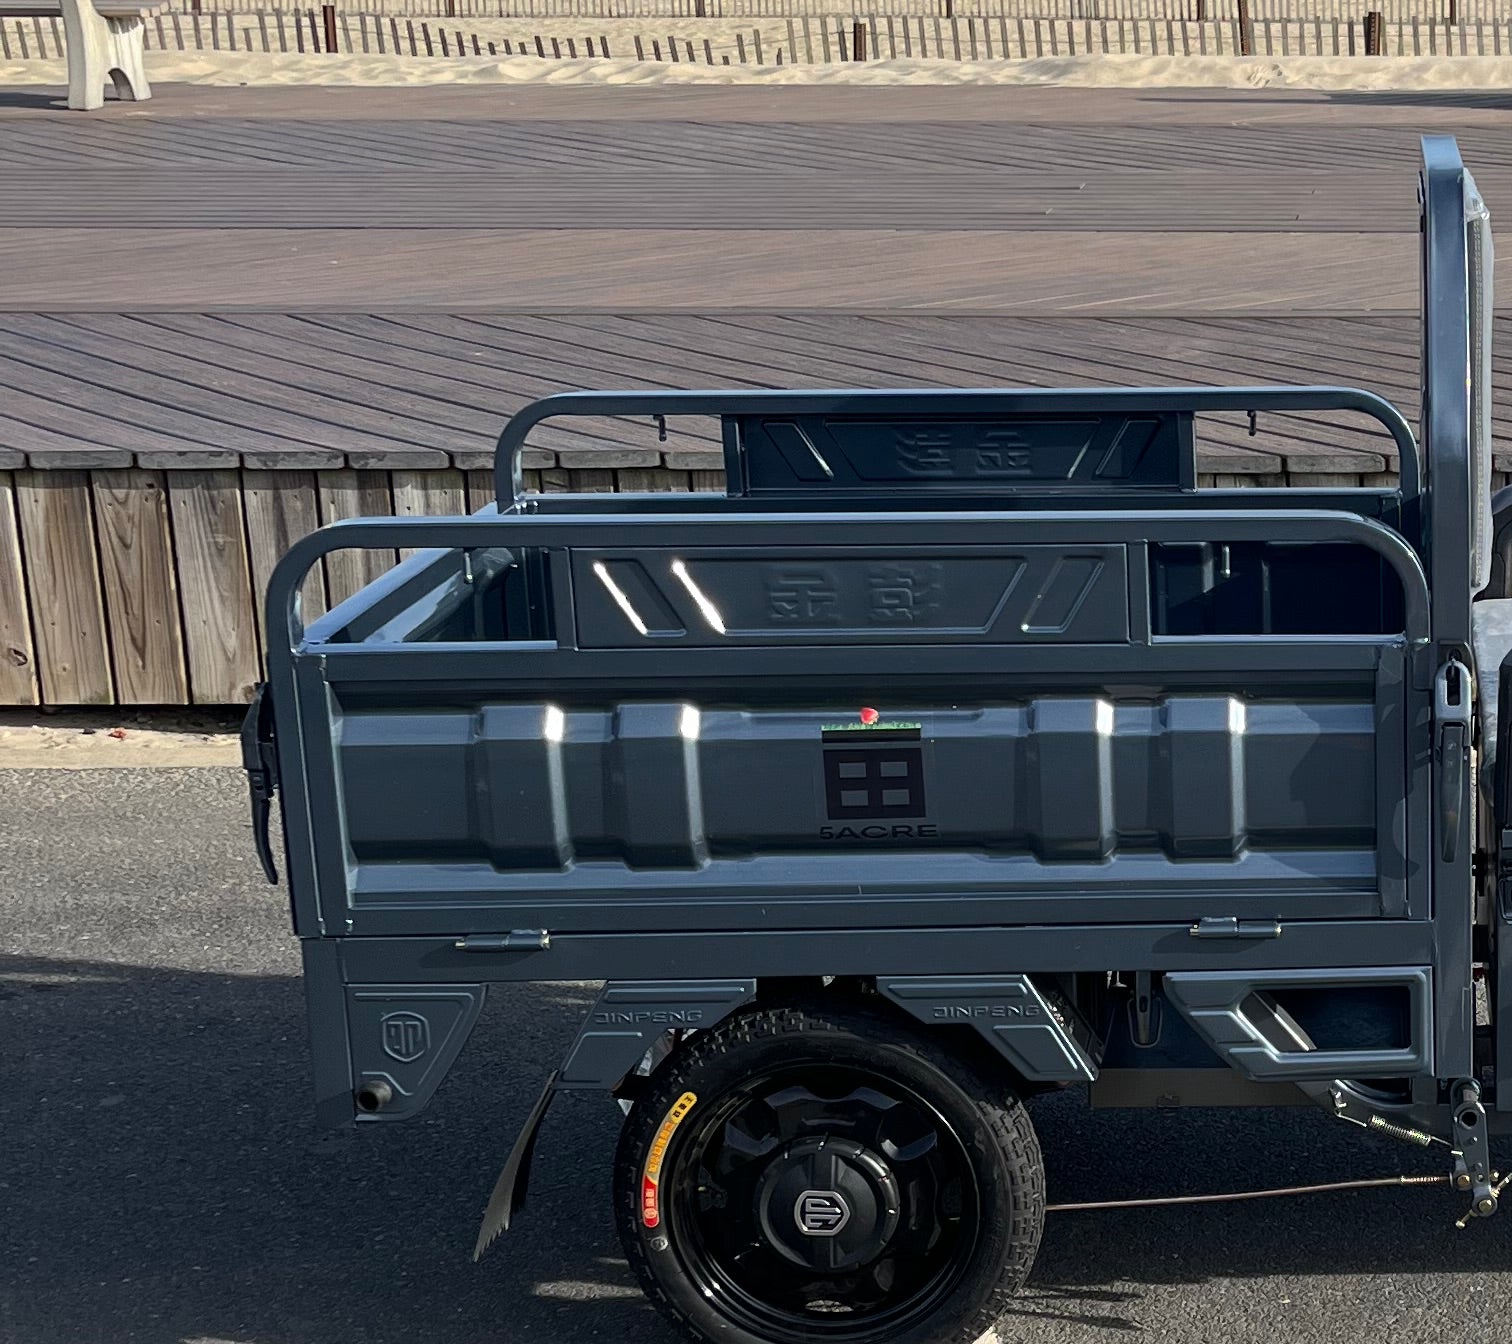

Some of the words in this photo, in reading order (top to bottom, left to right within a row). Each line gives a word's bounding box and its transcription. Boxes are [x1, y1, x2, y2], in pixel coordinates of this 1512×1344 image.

[819, 824, 938, 840] 5ACRE
[593, 1009, 703, 1024] JINPENG
[933, 1004, 1041, 1018] JINPENG
